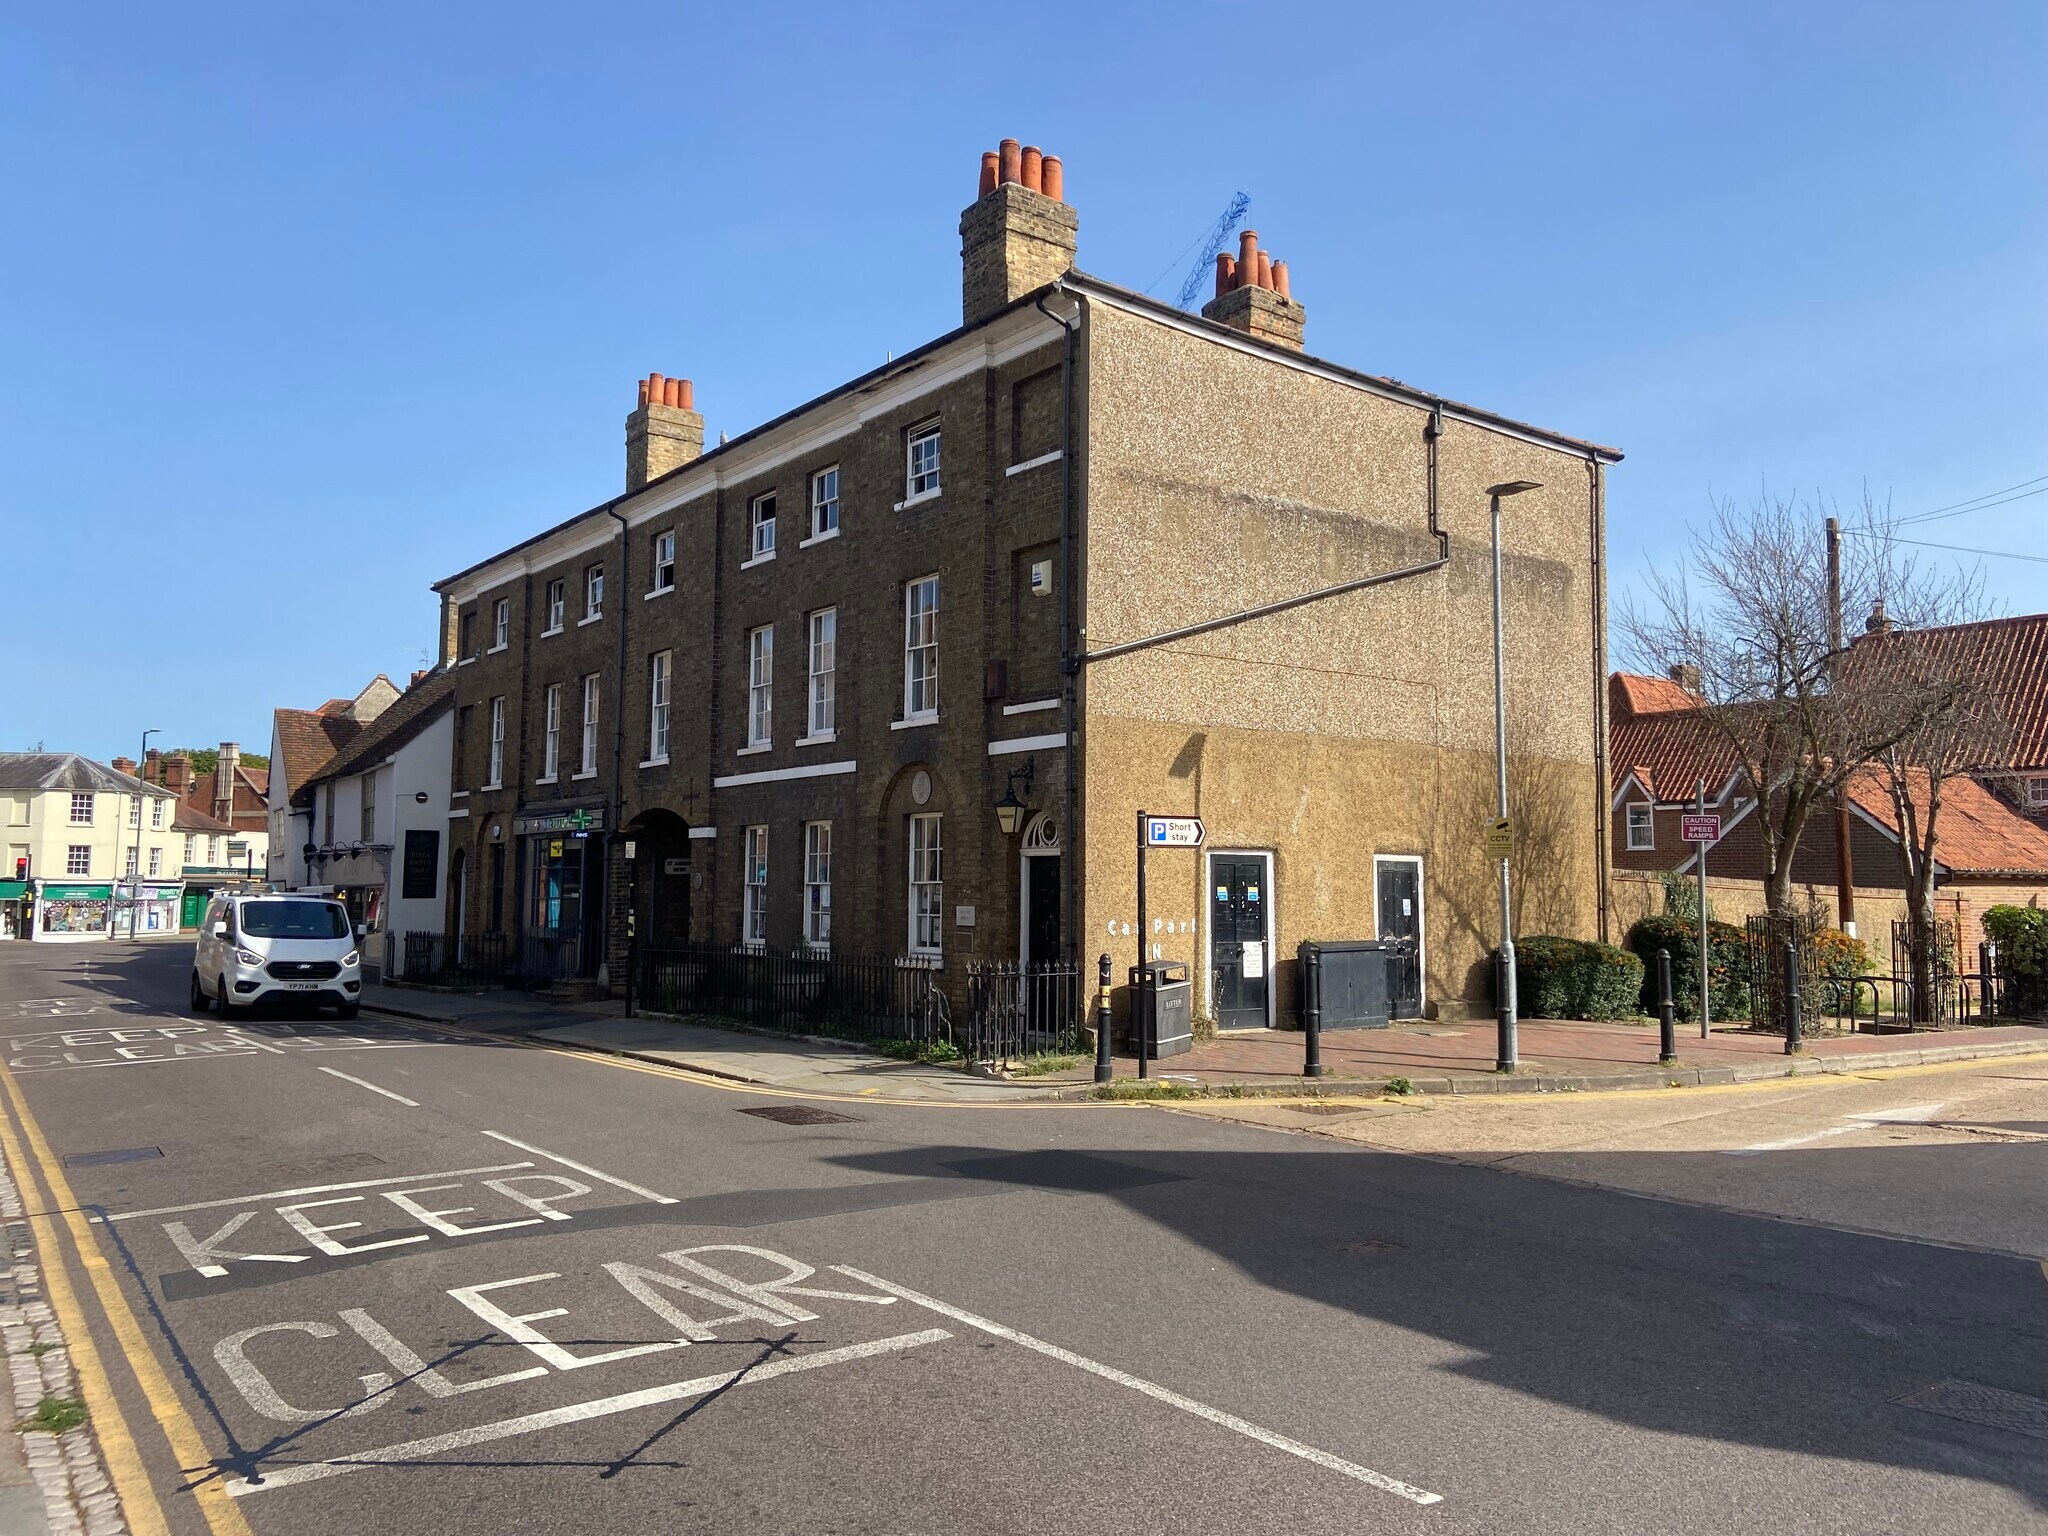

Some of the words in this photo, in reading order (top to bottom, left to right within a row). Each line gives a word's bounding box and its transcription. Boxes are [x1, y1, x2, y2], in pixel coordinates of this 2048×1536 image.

[1154, 823, 1165, 840] P
[1169, 822, 1191, 831] Short
[1171, 832, 1188, 842] stay
[1165, 998, 1183, 1008] LITTER
[10, 1027, 207, 1051] KEEP
[10, 1039, 258, 1067] CLEAR
[161, 1174, 592, 1279] KEEP
[212, 1244, 898, 1422] CLEAR
